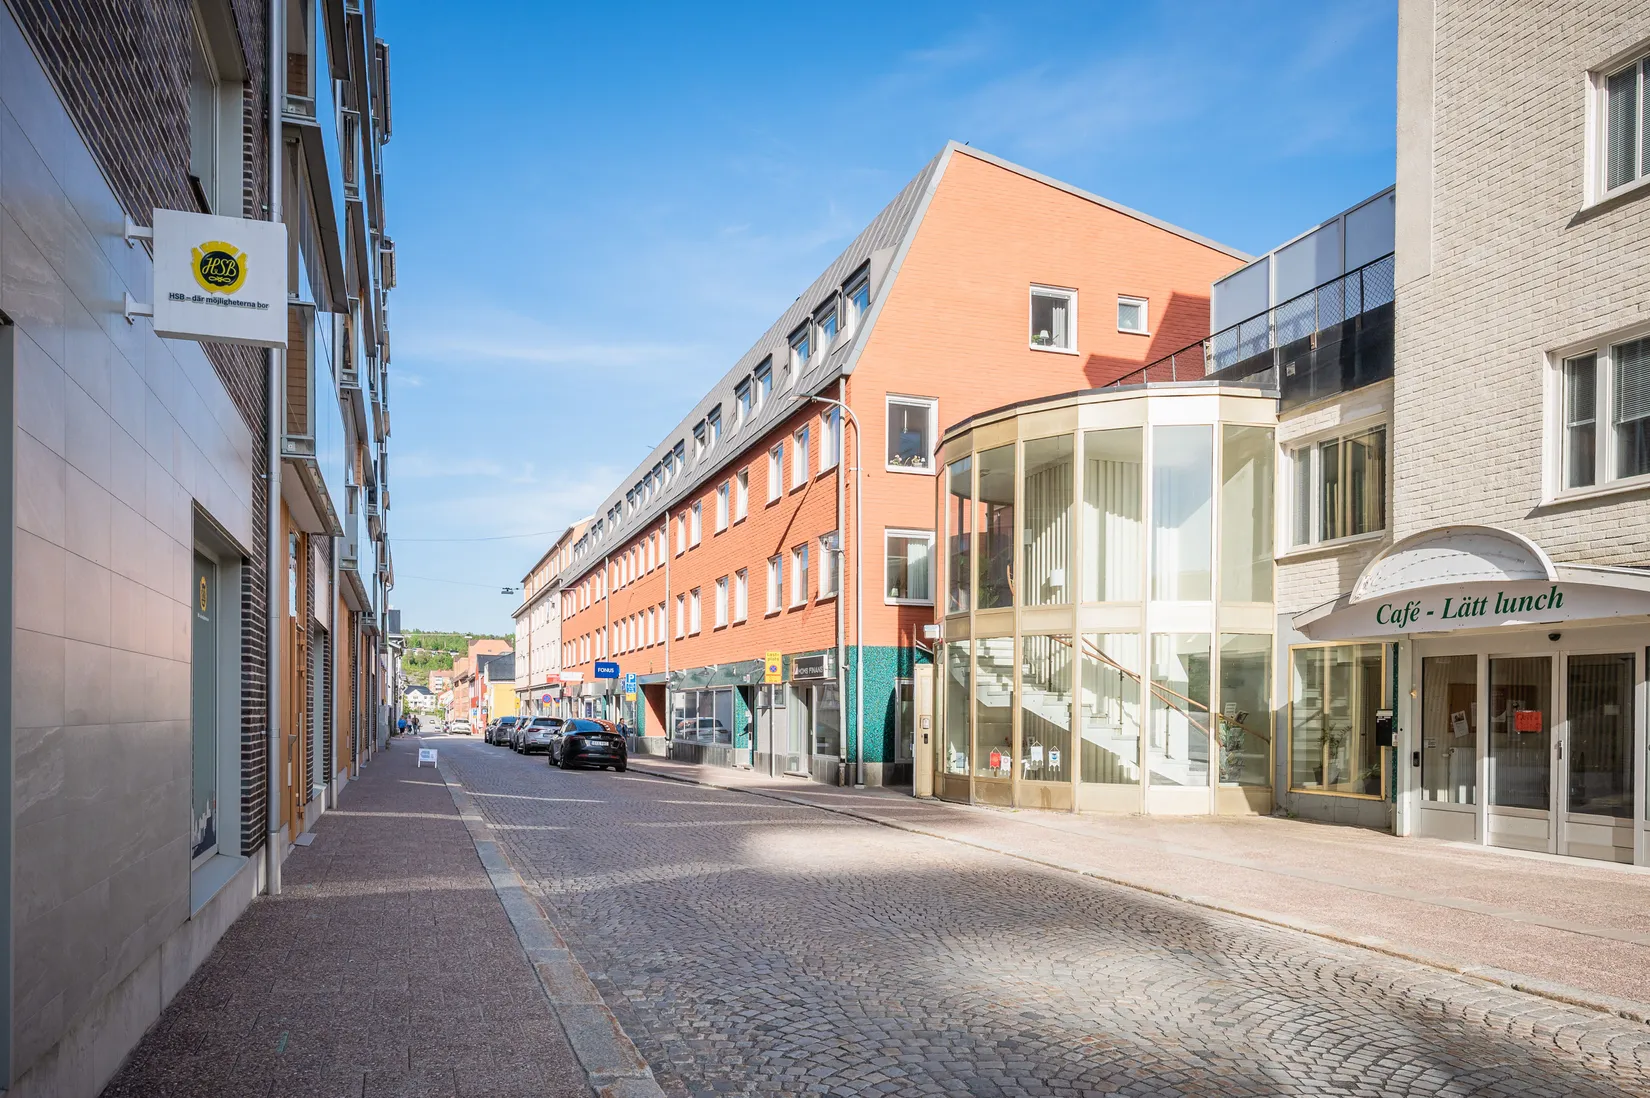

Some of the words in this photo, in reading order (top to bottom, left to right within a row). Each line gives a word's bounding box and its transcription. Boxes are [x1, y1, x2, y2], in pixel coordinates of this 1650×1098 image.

[202, 257, 237, 277] HSB
[169, 292, 185, 301] HSB
[192, 294, 205, 303] där
[206, 296, 256, 308] möjligheterna
[257, 301, 269, 309] bor
[1376, 600, 1422, 629] Café
[1440, 595, 1489, 620] Lätt
[1494, 585, 1564, 615] lunch
[628, 674, 635, 683] P
